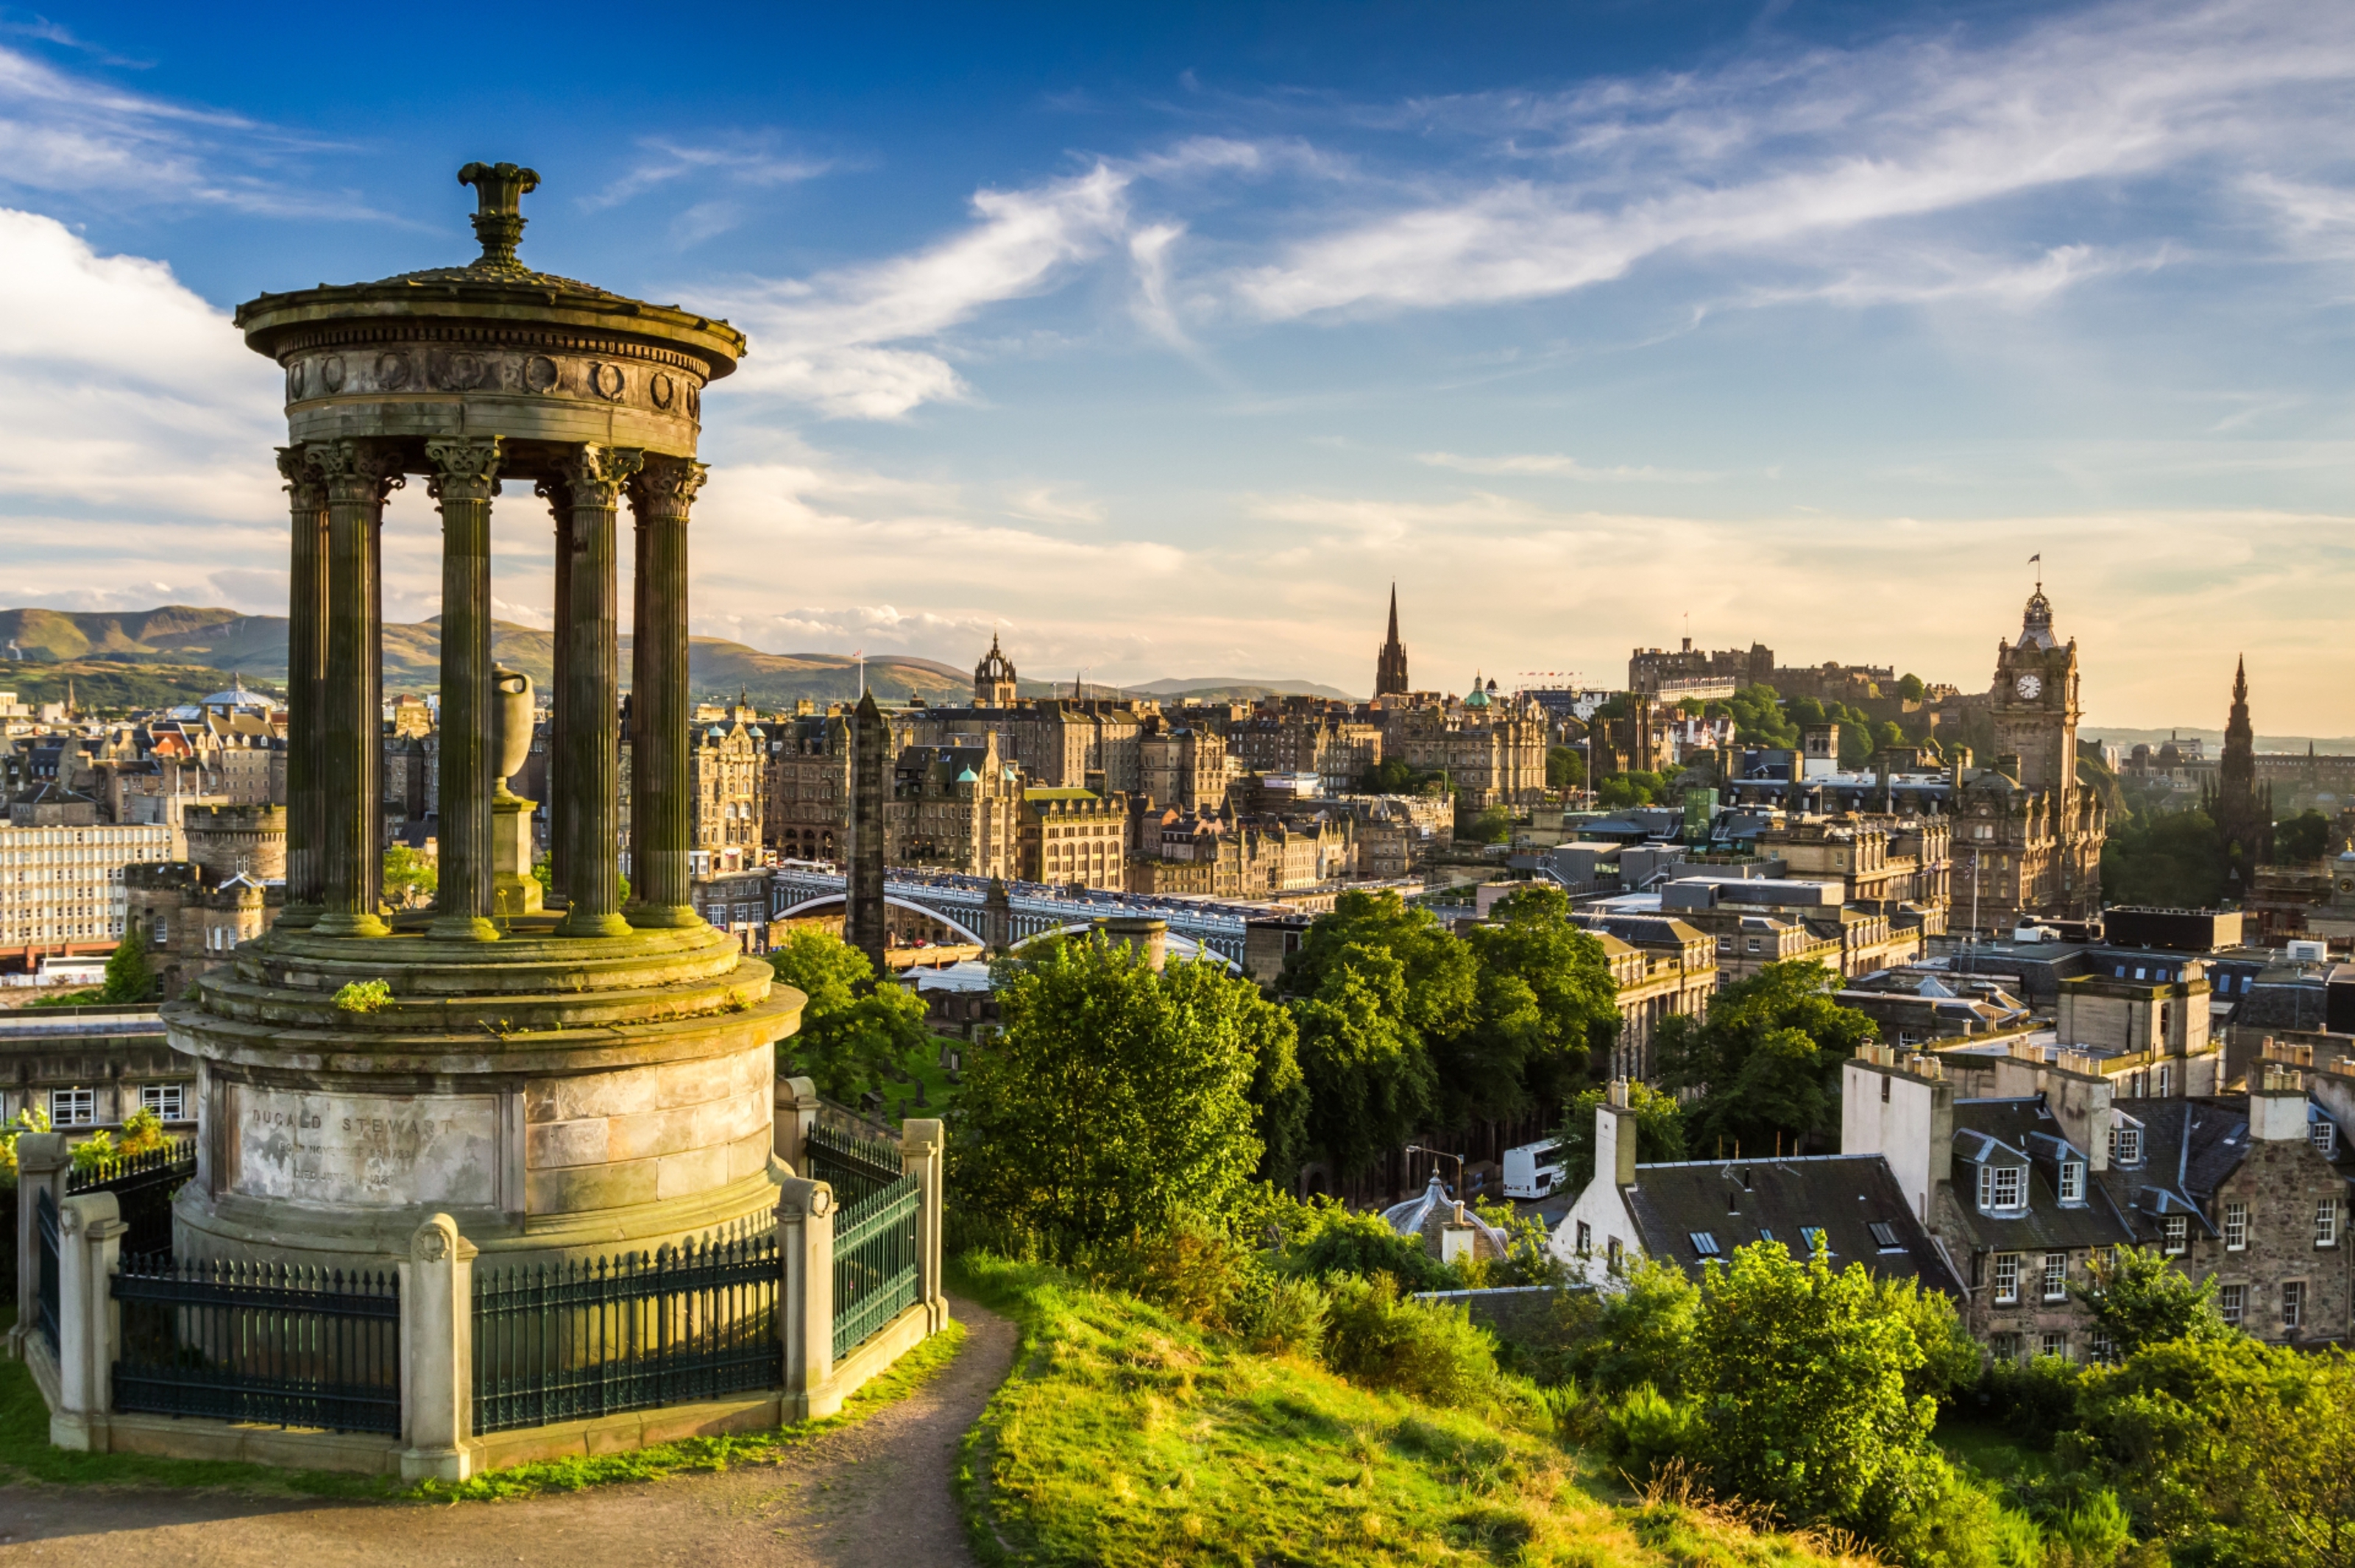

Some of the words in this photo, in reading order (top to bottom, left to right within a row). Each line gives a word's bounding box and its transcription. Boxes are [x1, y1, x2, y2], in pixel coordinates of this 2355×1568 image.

[252, 1109, 322, 1129] DUGALD
[342, 1117, 453, 1135] STEWART
[294, 1170, 316, 1179] DIED
